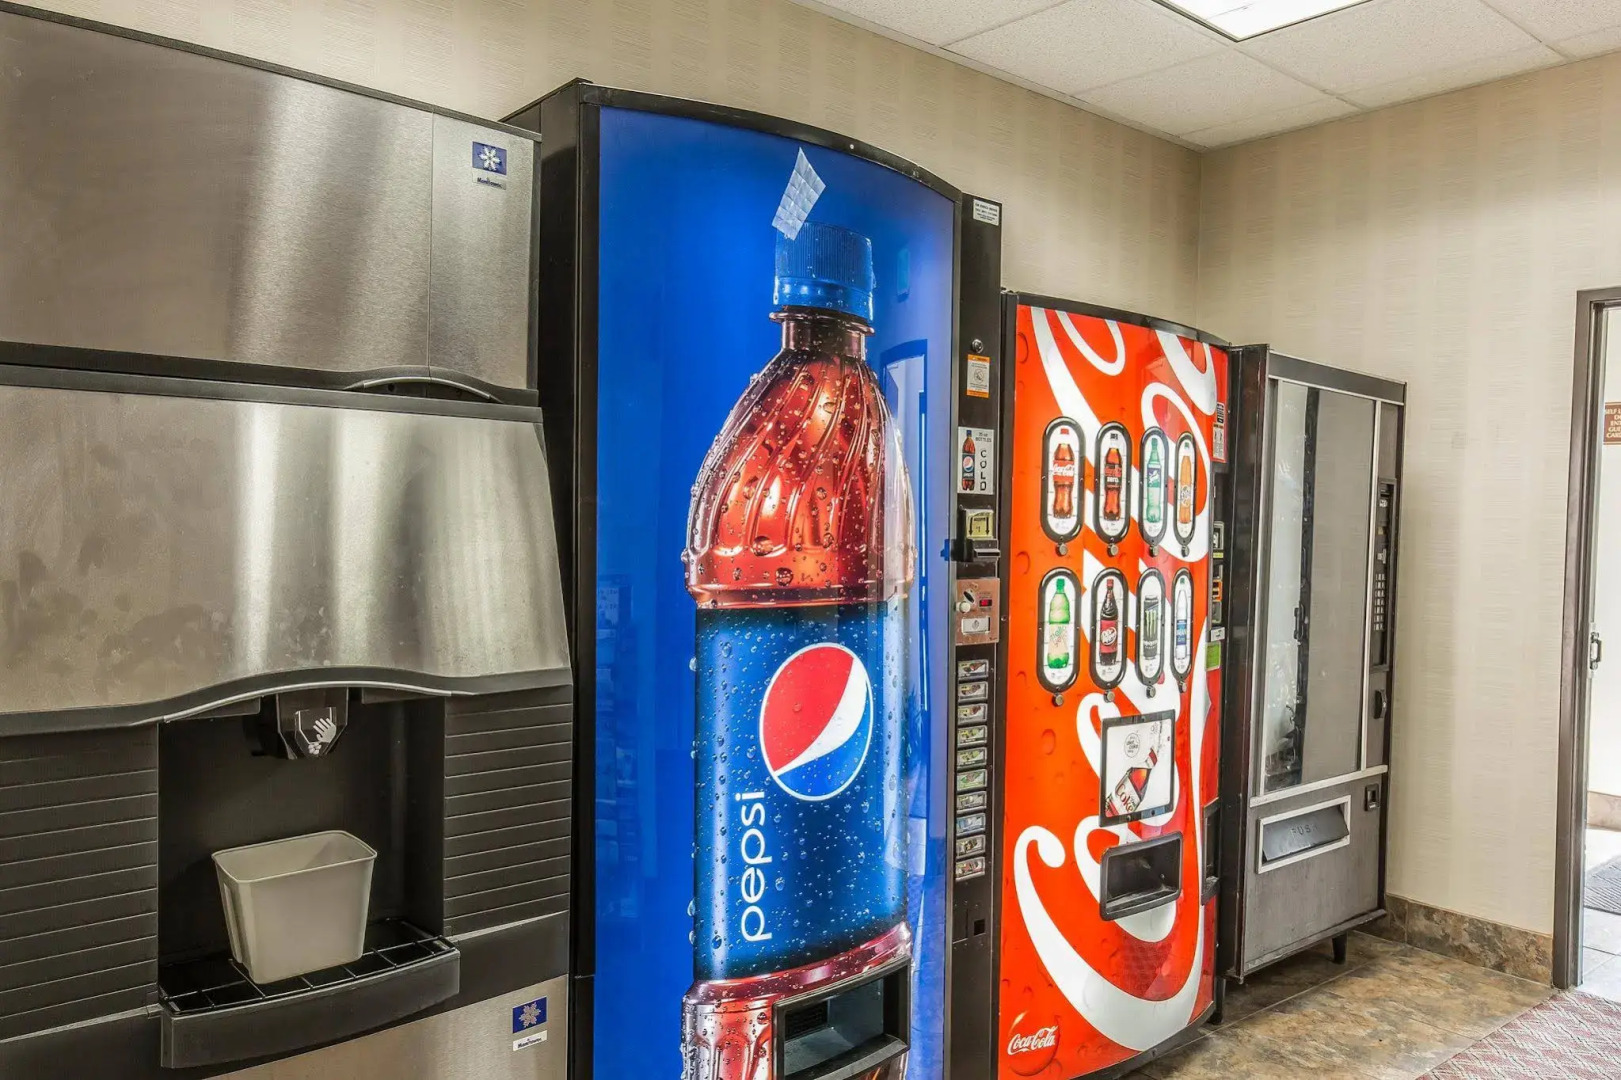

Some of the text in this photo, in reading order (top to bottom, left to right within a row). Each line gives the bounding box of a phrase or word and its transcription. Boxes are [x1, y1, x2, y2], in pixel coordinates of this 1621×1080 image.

[979, 450, 988, 491] COLD
[734, 791, 773, 942] pepsi
[1007, 1025, 1059, 1056] Coca-Cola
